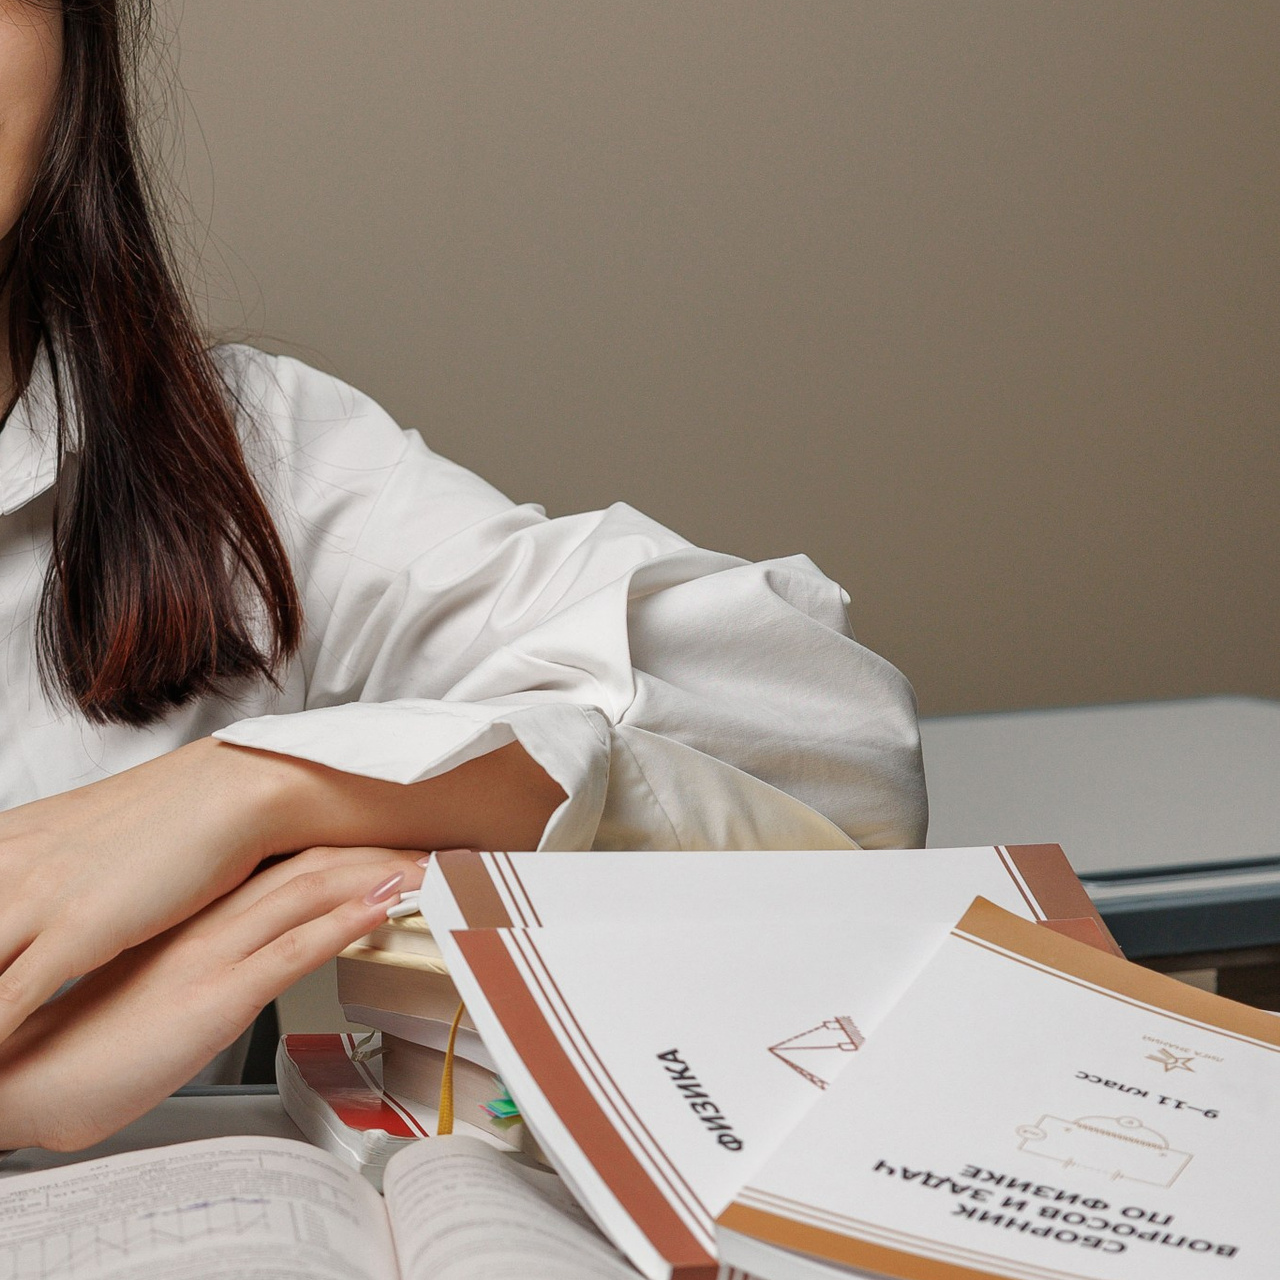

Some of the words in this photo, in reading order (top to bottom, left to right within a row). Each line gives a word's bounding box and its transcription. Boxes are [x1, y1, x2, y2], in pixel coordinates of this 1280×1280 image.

[656, 1048, 743, 1151] ФИЗИКА
[1074, 1070, 1149, 1098] класс
[872, 1159, 996, 1202] ЗАДАЧ
[961, 1163, 1111, 1210] ФИЗИКЕ
[1001, 1195, 1028, 1213] И
[1121, 1205, 1175, 1226] ПО
[951, 1203, 1129, 1255] СБОРНИК
[1039, 1206, 1239, 1258] ВОПРОСОВ
